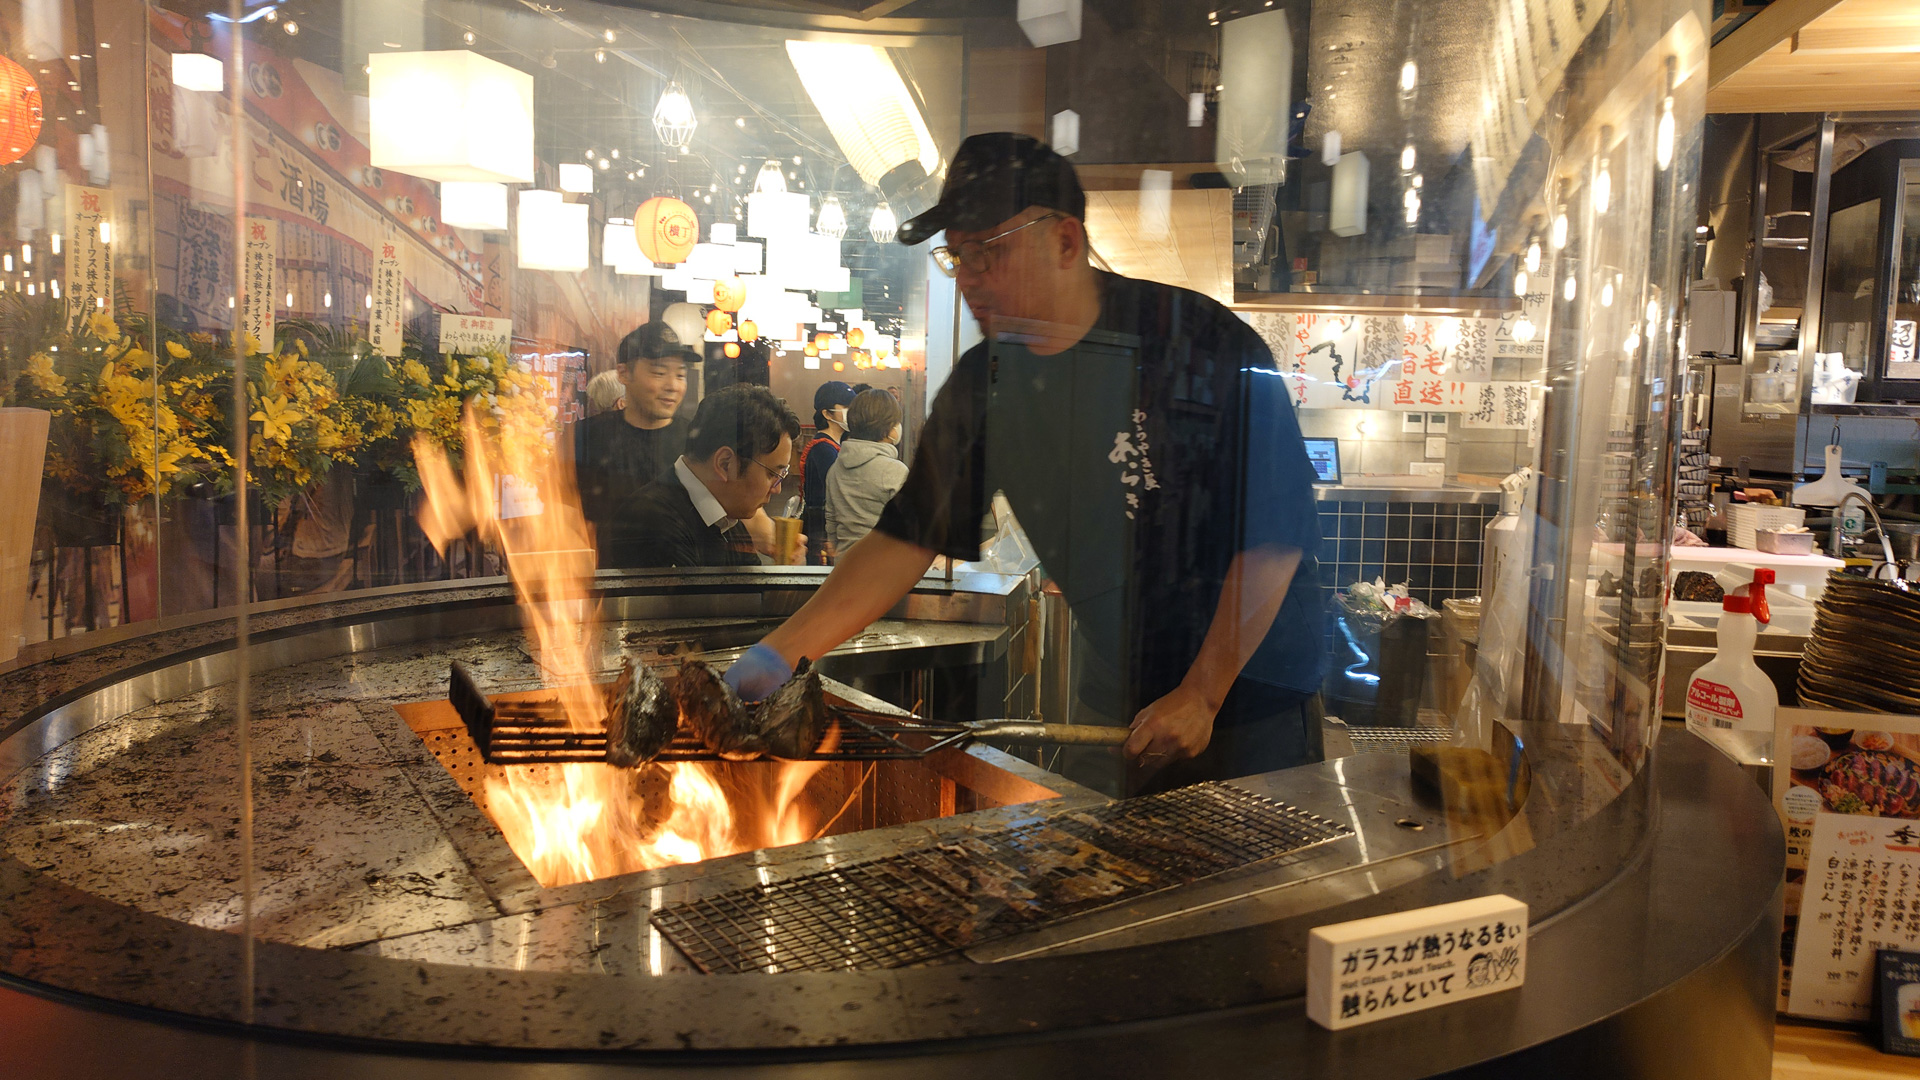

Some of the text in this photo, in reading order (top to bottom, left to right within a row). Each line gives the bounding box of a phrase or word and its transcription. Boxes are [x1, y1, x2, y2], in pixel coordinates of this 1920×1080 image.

[80, 191, 100, 212] 祝
[76, 212, 102, 222] オープ
[251, 222, 267, 240] 祝
[669, 224, 690, 238] 横丁
[247, 241, 271, 249] オープン
[382, 243, 396, 259] 祝
[379, 259, 400, 267] オープン
[253, 252, 263, 340] 株式会社クライマックス
[384, 269, 393, 327] 株式会社ハート
[1690, 686, 1736, 709] アルコール製剤
[1718, 706, 1741, 716] アルペット
[1789, 826, 1811, 838] 鰹の
[1821, 857, 1840, 903] 白ごはん
[1391, 970, 1404, 980] Do
[1407, 966, 1425, 976] Not
[1340, 974, 1455, 1019] 触らんといて
